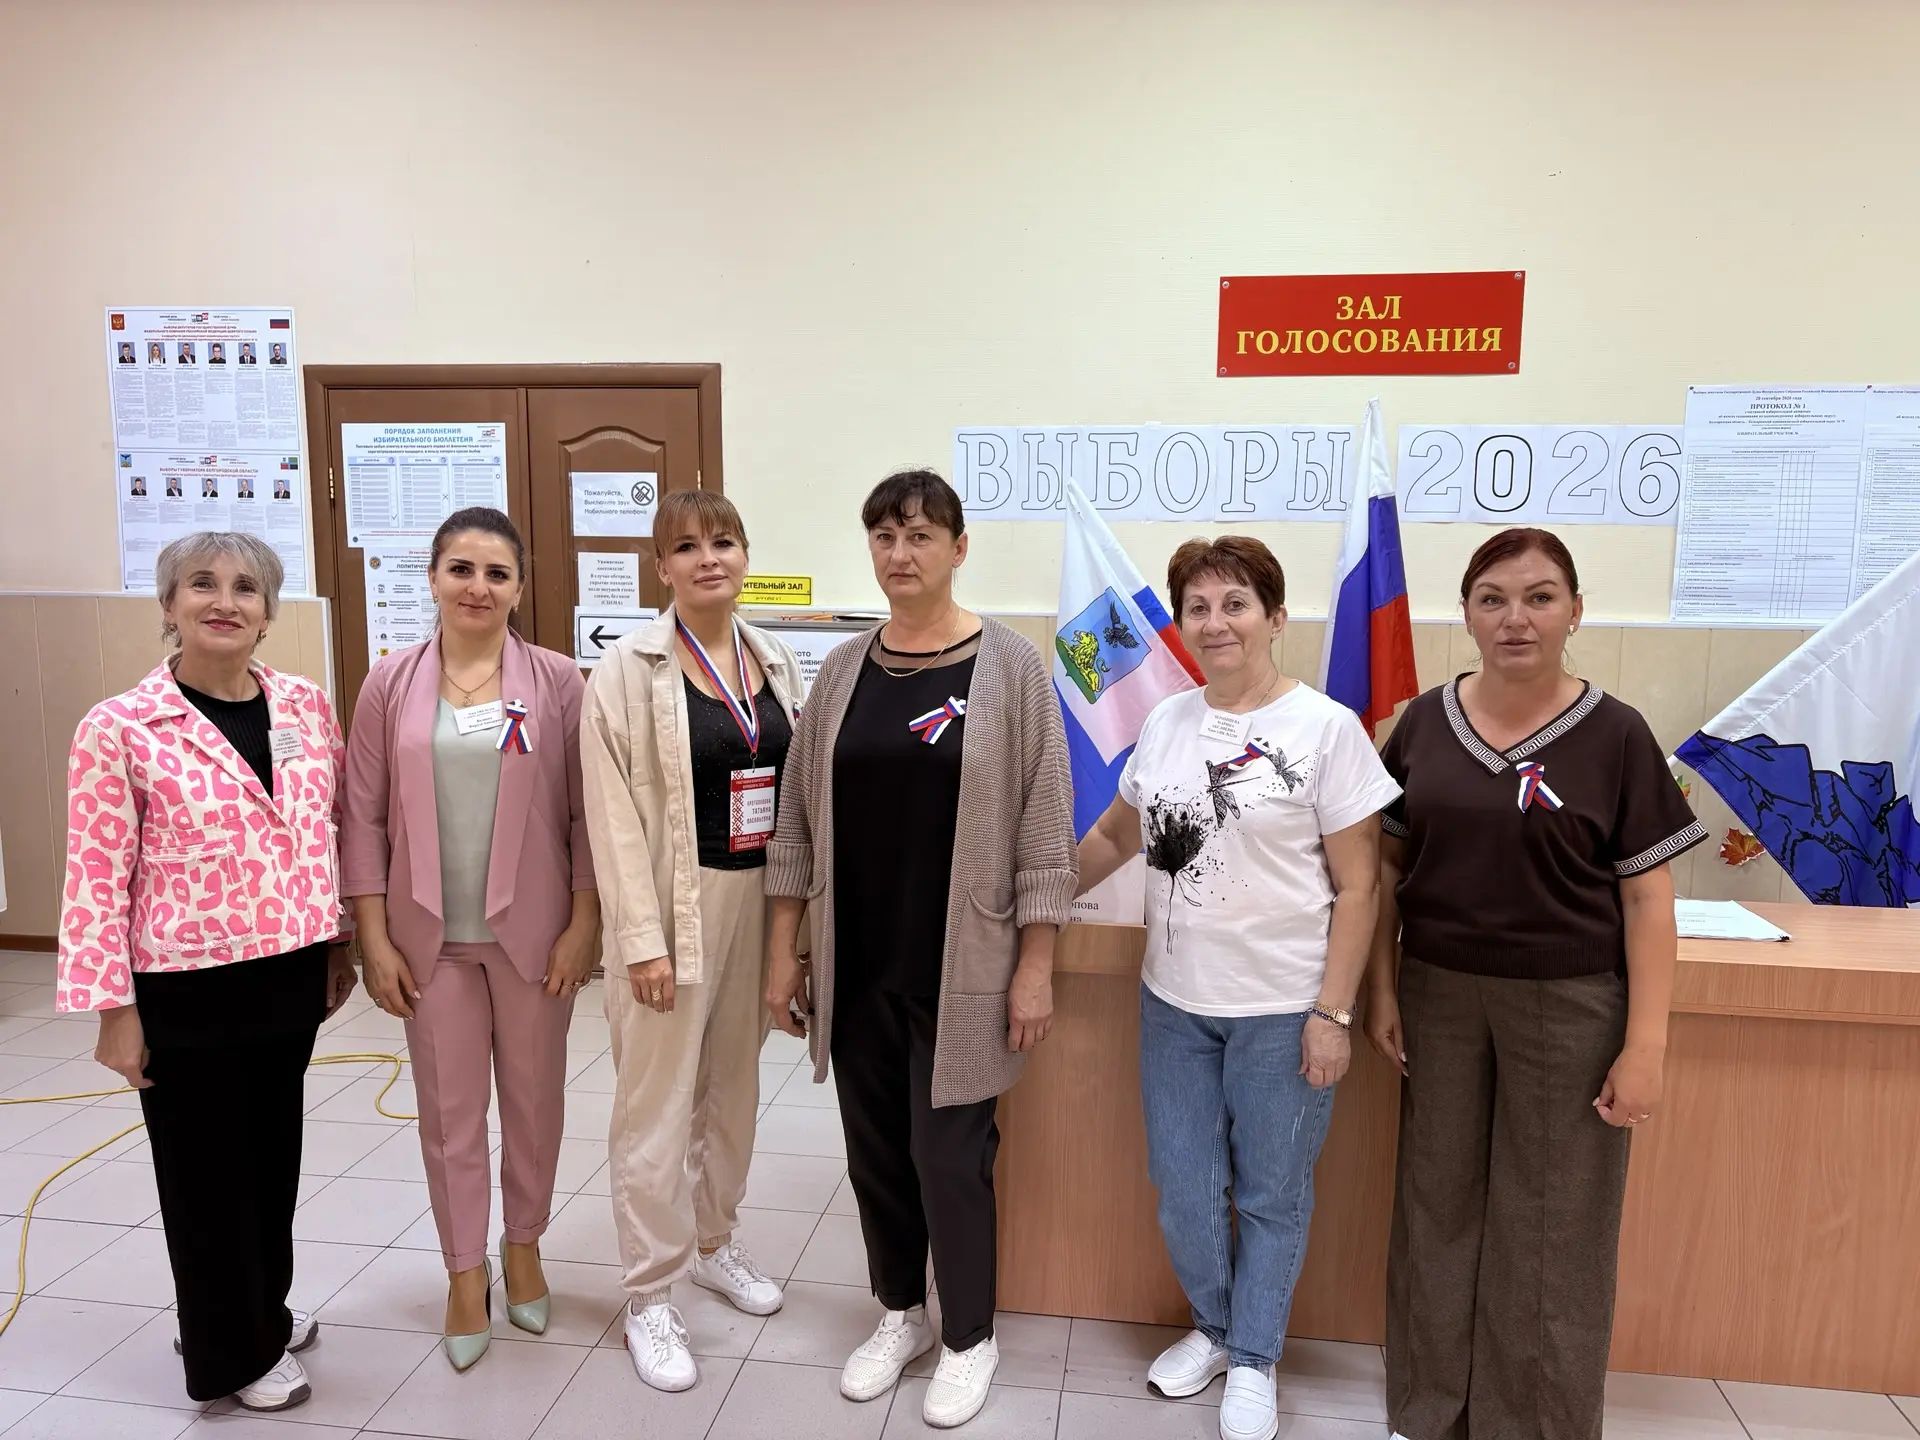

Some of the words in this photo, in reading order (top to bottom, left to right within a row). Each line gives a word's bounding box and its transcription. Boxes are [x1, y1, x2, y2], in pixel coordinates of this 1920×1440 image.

[1335, 295, 1403, 320] ЗАЛ
[1235, 326, 1504, 355] ГОЛОСОВАНИЯ
[958, 431, 1350, 514] ВЫБОРЫ
[1405, 430, 1682, 517] 2026
[584, 489, 624, 497] Пожалуйста,
[752, 806, 771, 815] ТАТЬЯНА
[747, 815, 771, 824] ВАСИЛЬЕВНА
